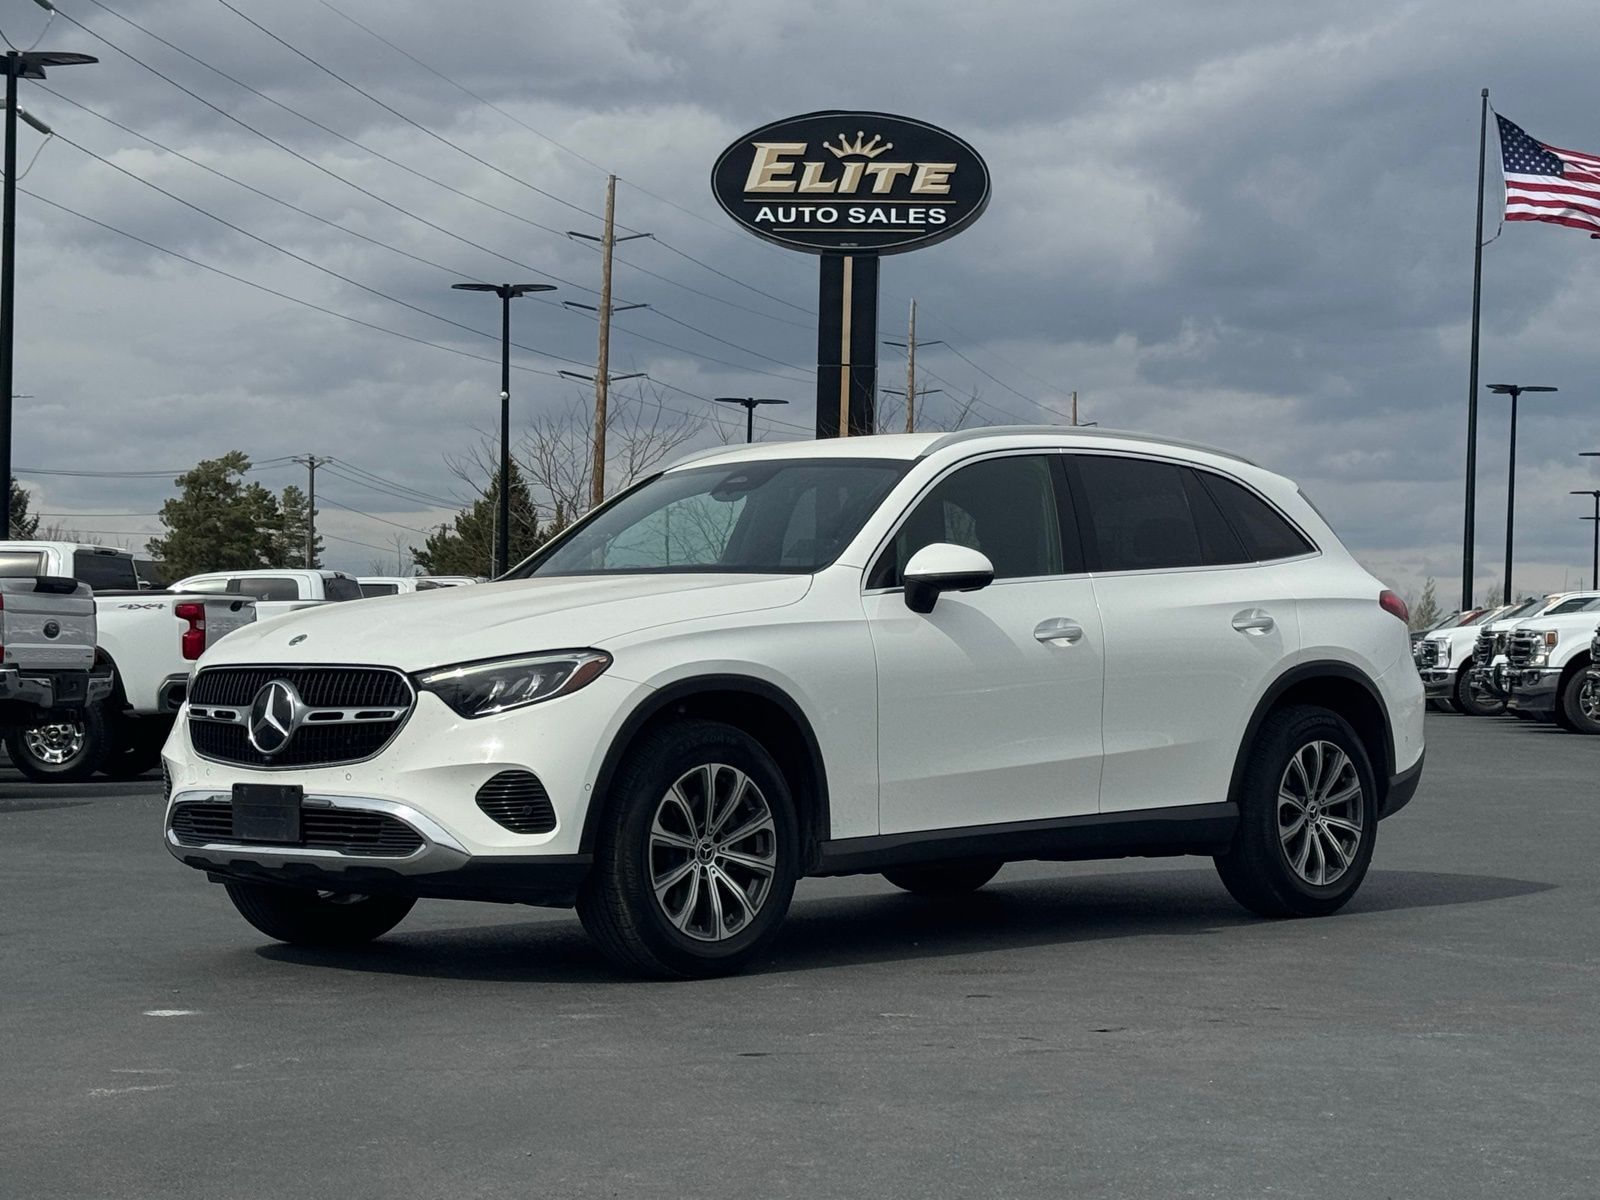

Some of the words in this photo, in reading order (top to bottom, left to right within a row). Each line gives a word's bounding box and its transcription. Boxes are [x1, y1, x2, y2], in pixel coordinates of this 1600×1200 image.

[743, 142, 957, 194] ELITE
[754, 206, 838, 223] AUTO
[848, 207, 947, 224] SALES
